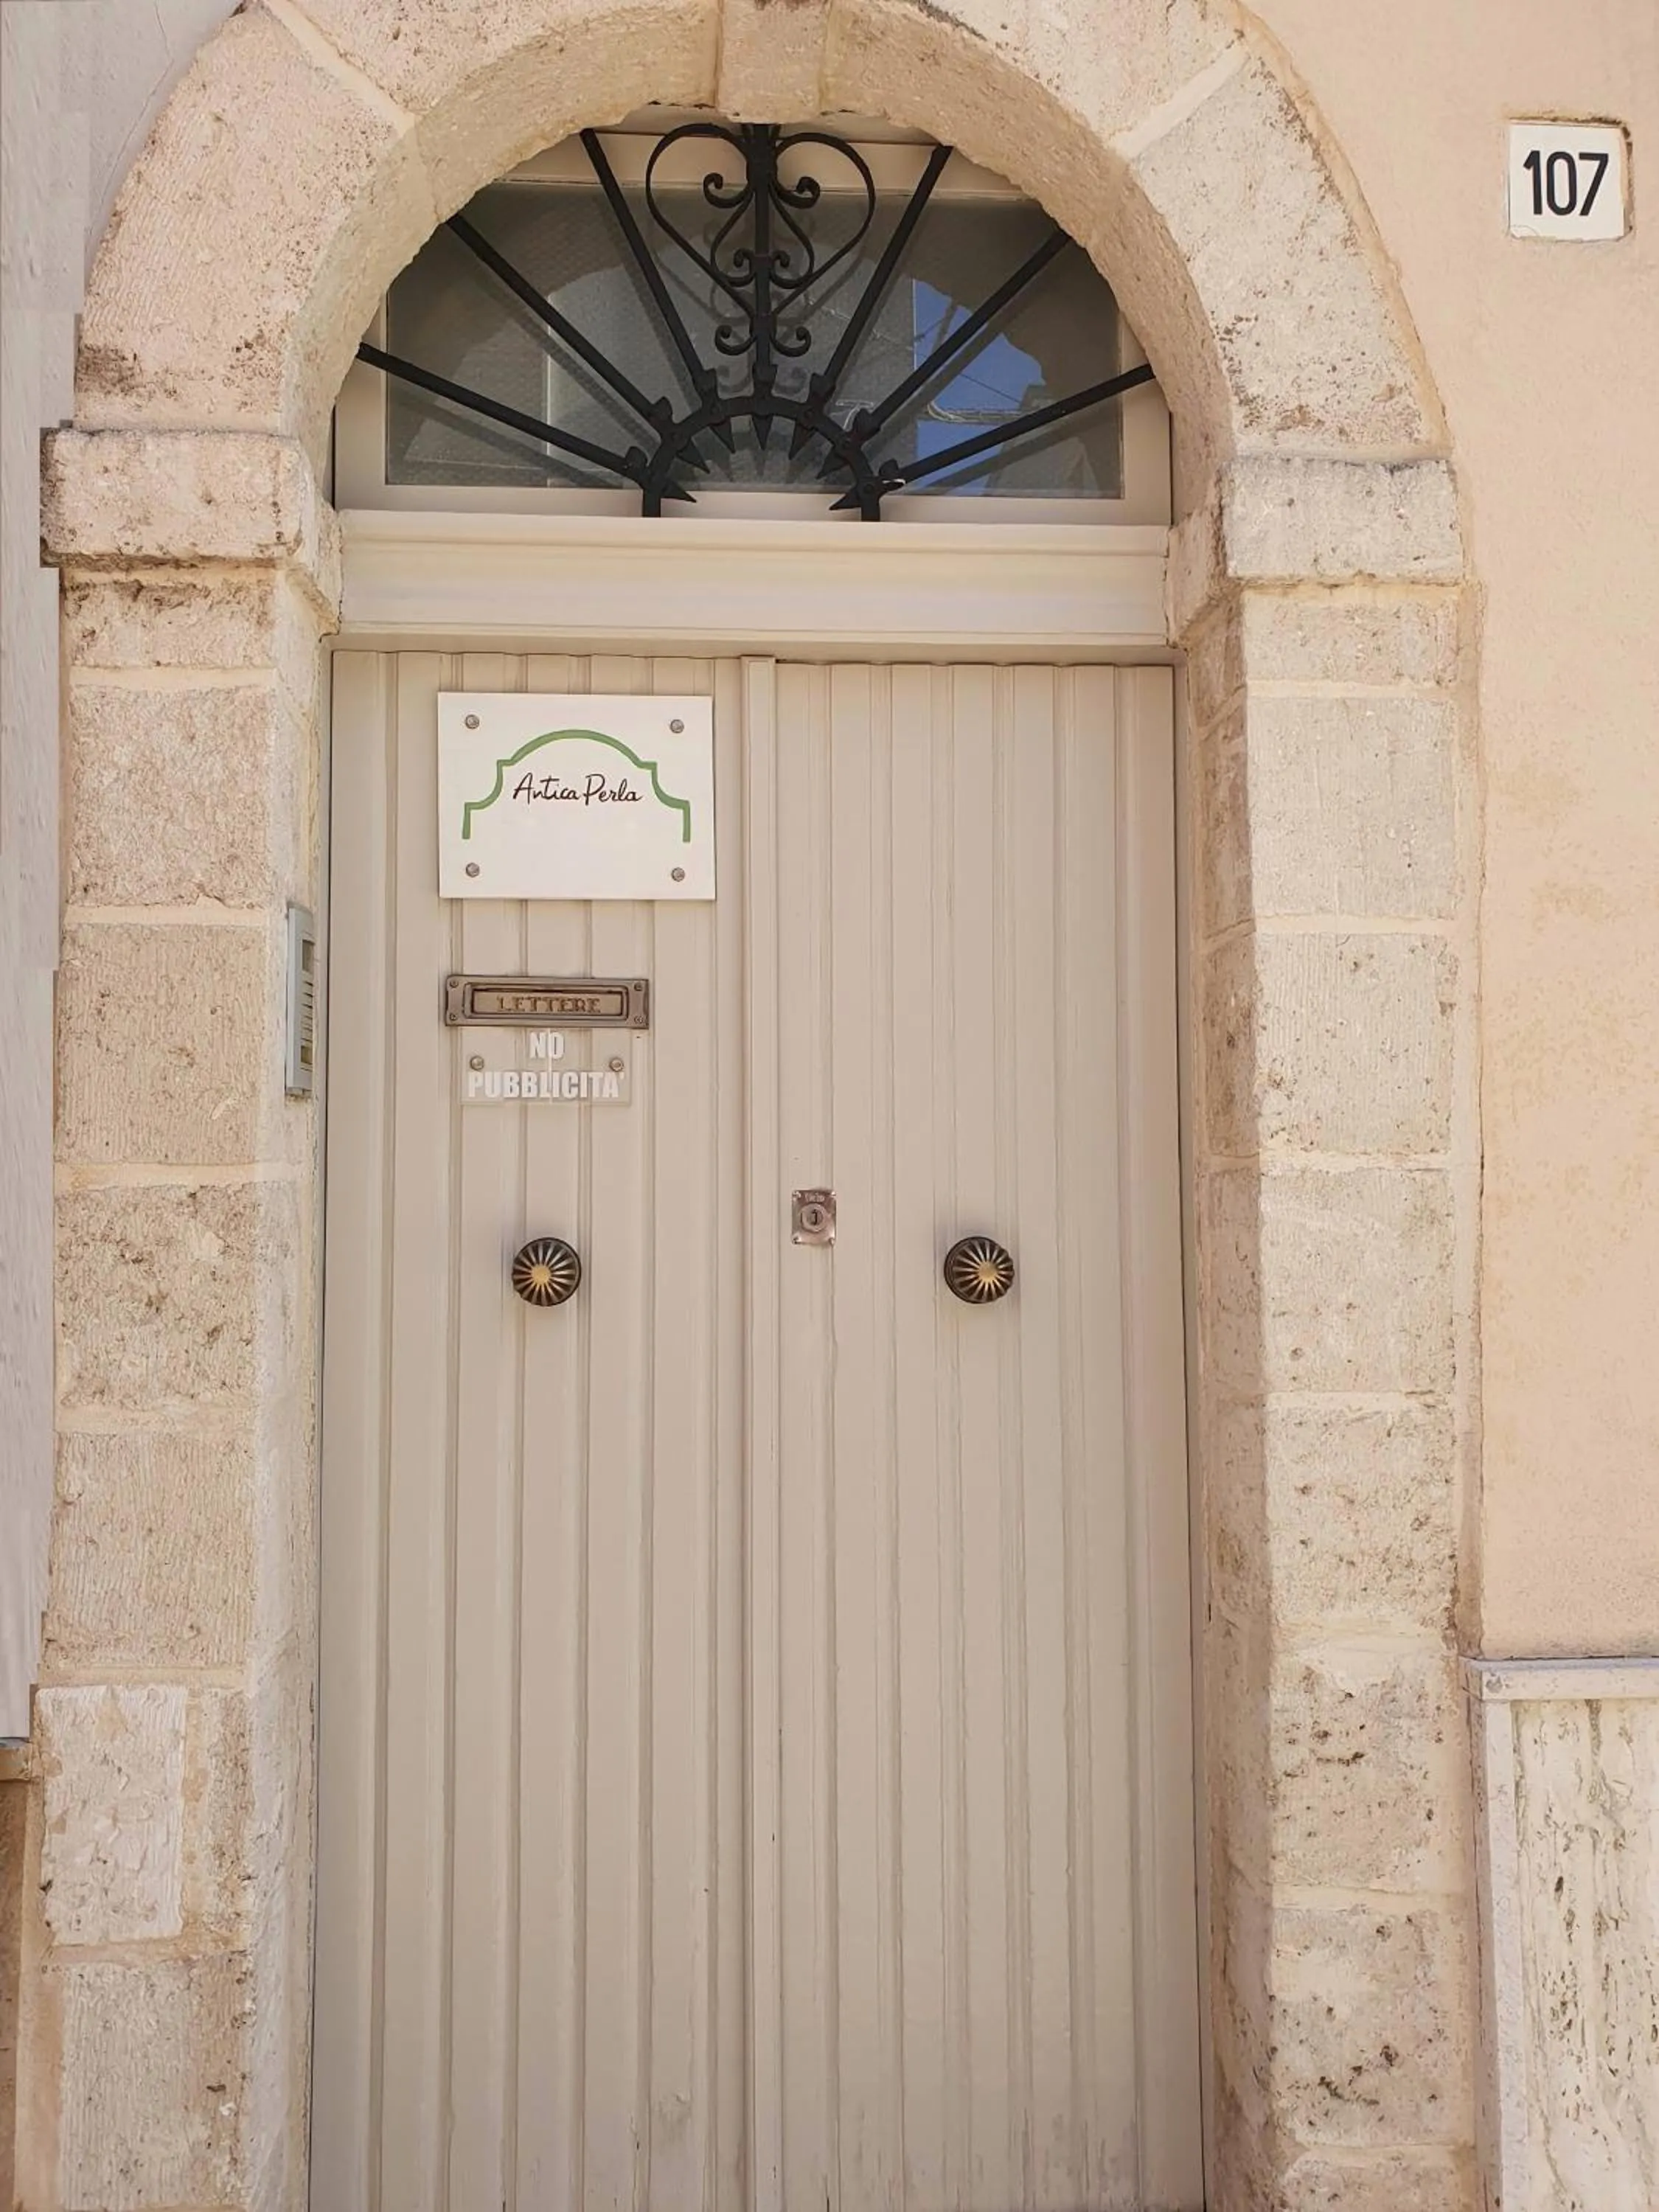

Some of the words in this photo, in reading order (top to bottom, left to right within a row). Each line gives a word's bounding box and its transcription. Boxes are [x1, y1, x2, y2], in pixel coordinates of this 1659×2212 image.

[1523, 150, 1609, 216] 107
[512, 772, 580, 804] Antica
[582, 773, 643, 806] Perla
[496, 995, 601, 1014] LETTERE
[529, 1031, 566, 1060] NO
